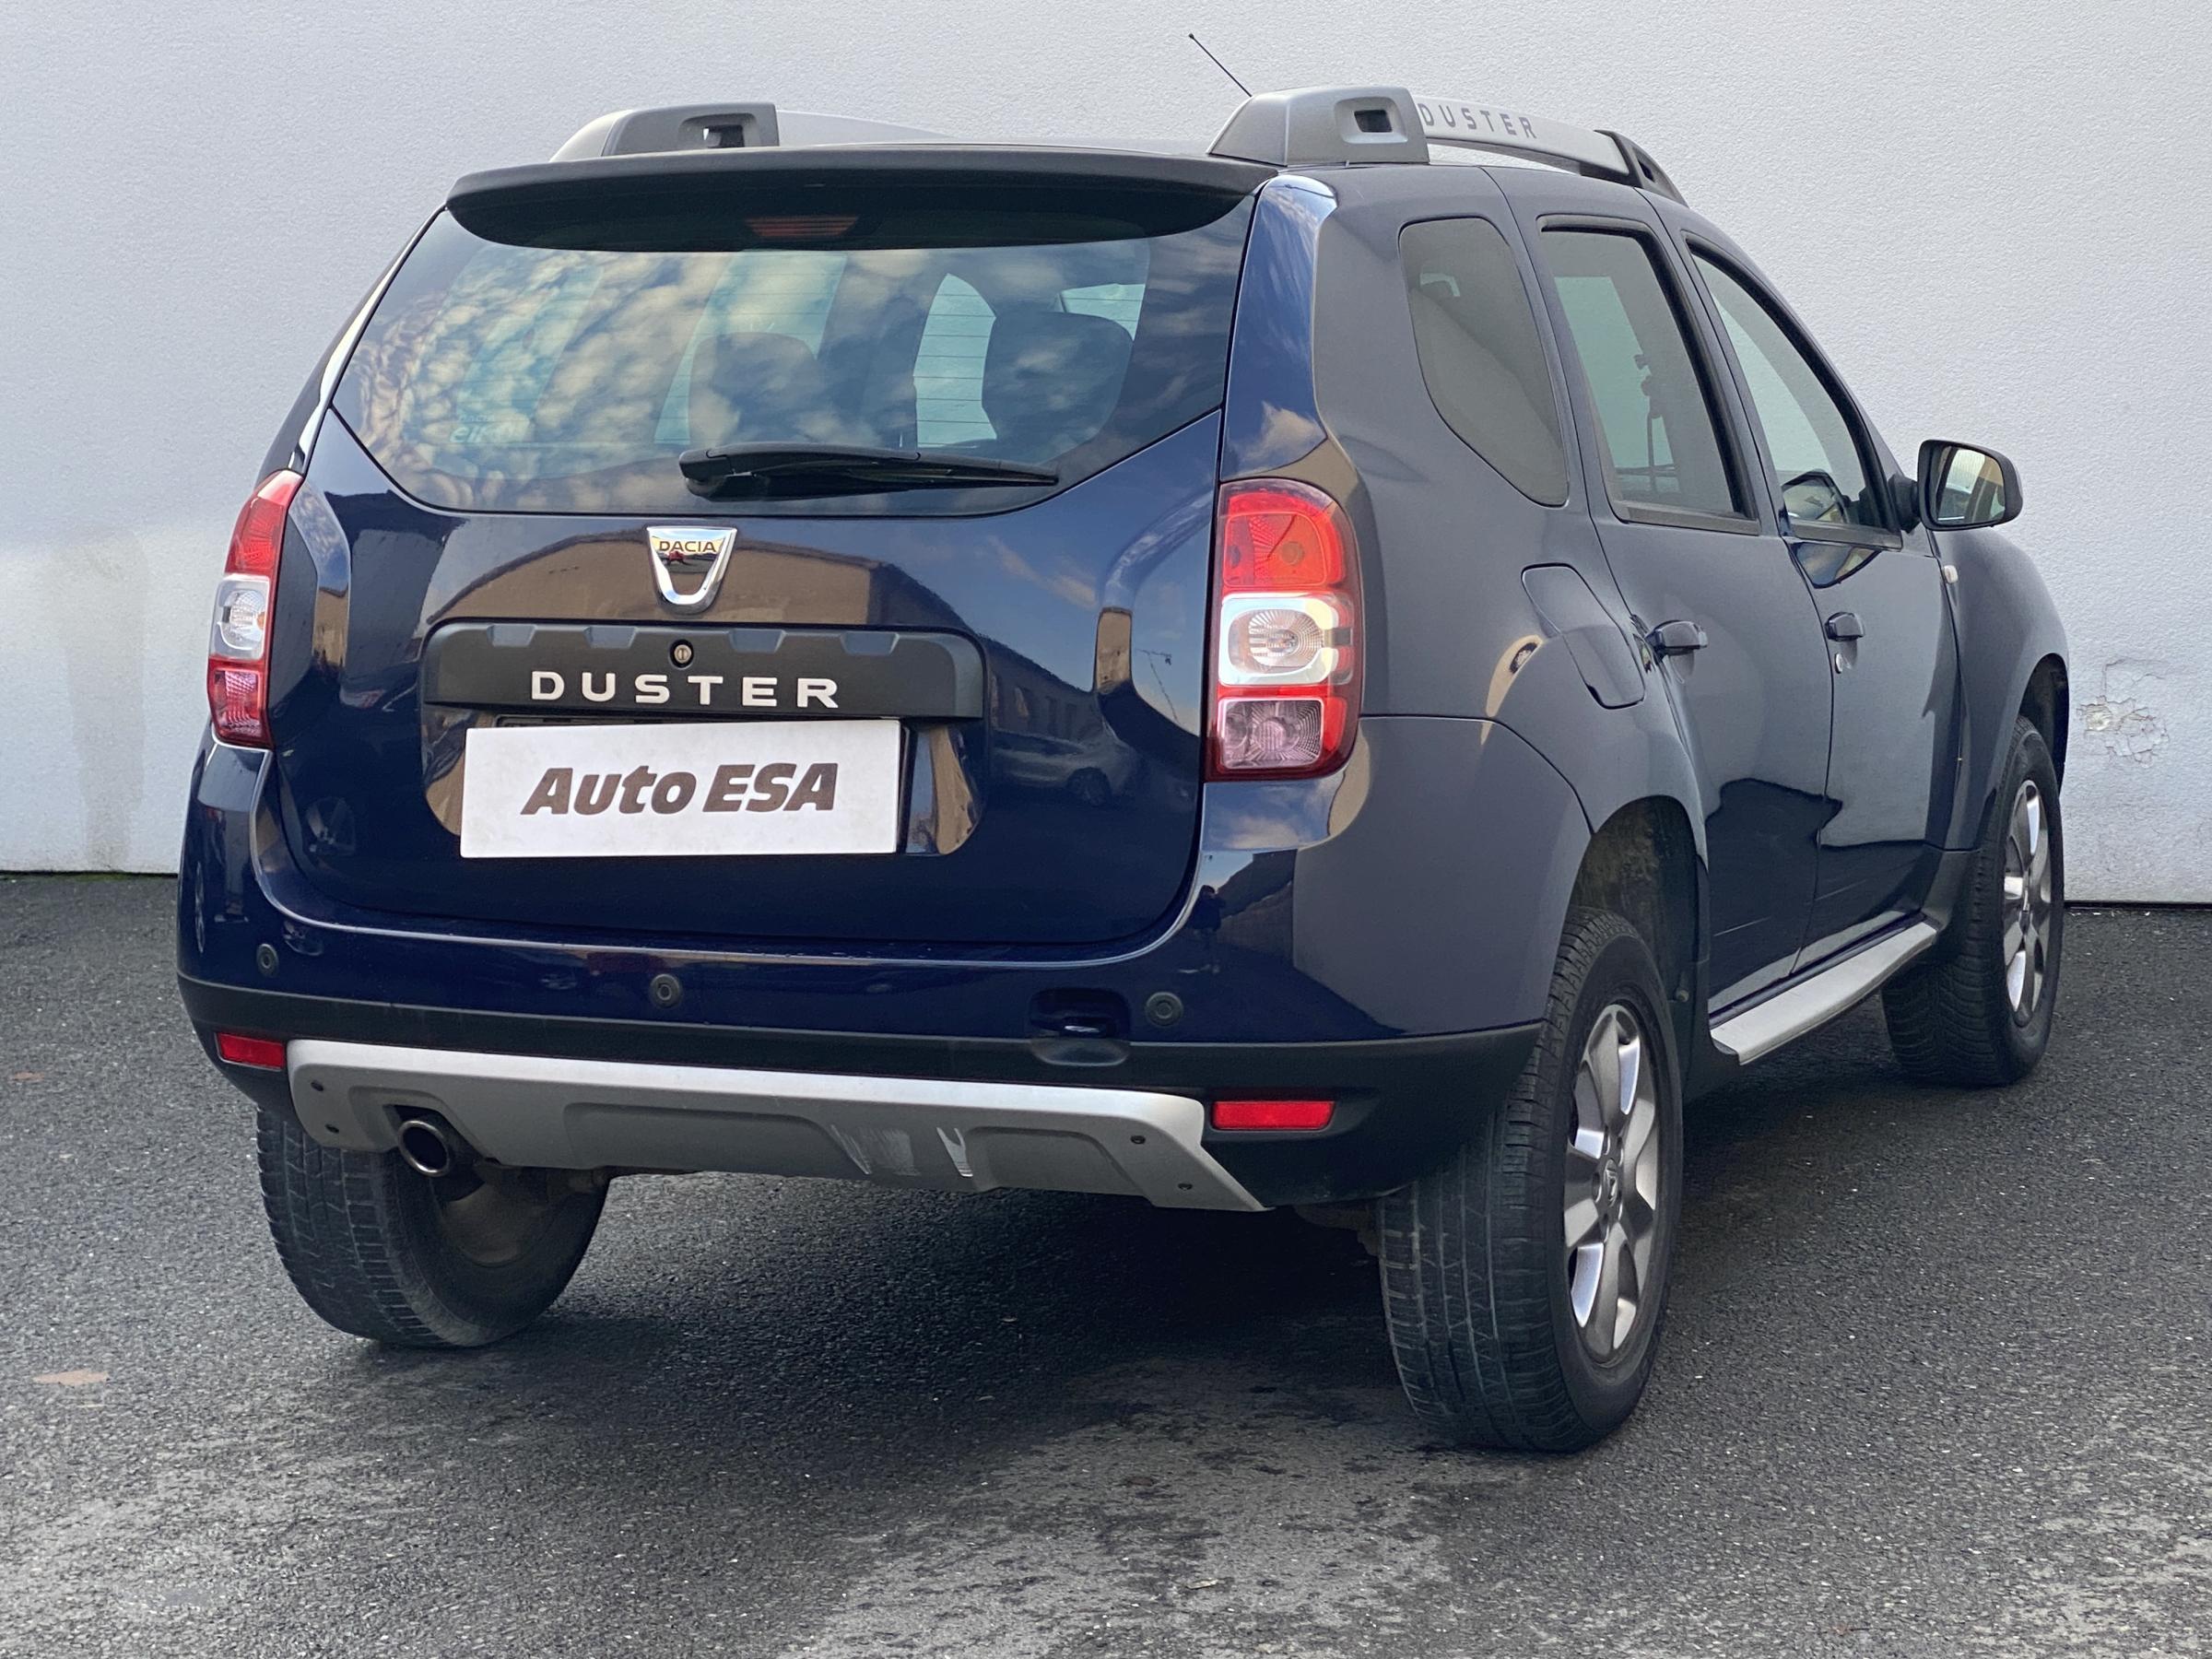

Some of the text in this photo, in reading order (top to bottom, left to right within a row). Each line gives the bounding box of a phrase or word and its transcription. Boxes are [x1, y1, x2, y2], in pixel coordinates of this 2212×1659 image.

[1418, 103, 1537, 139] DUSTER
[659, 540, 716, 552] DACIA
[531, 670, 839, 709] DUSTER
[520, 762, 839, 816] Auto ESA
